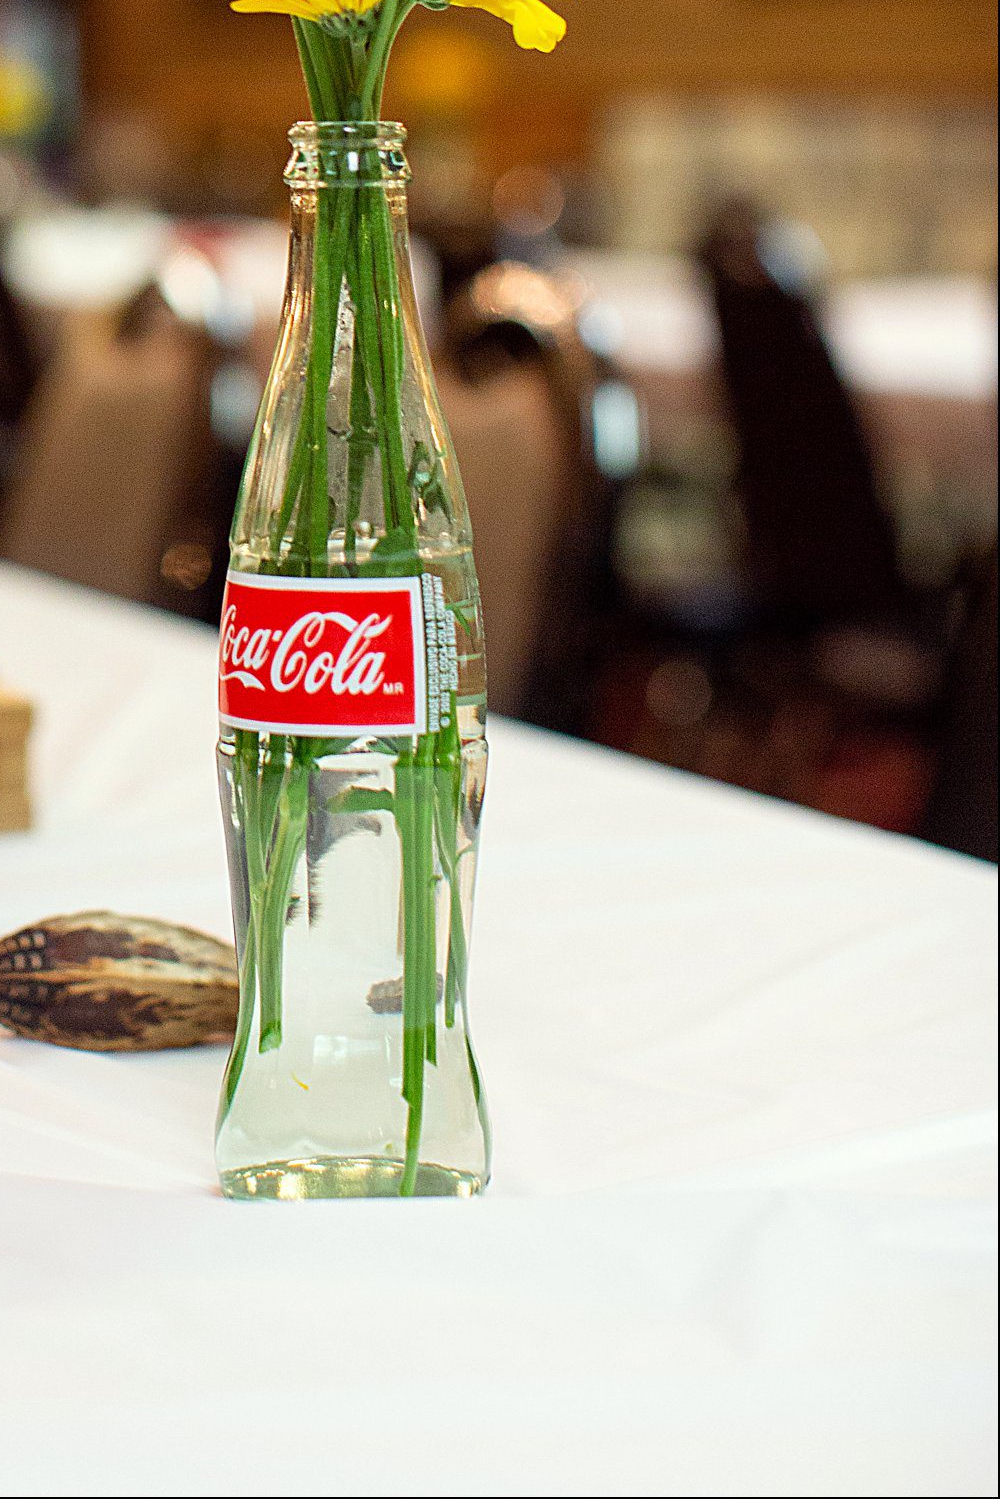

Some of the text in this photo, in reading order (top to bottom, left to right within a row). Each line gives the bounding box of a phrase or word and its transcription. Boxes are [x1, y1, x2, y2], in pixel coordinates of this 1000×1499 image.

[433, 576, 446, 621] COMPANY
[421, 573, 440, 733] ENVASE EXCLUSIVO PARA REFRESCO
[437, 621, 449, 672] COCA-COLA
[446, 646, 457, 659] EN
[383, 681, 405, 695] MR
[439, 672, 450, 691] THE
[447, 660, 458, 691] HECHO
